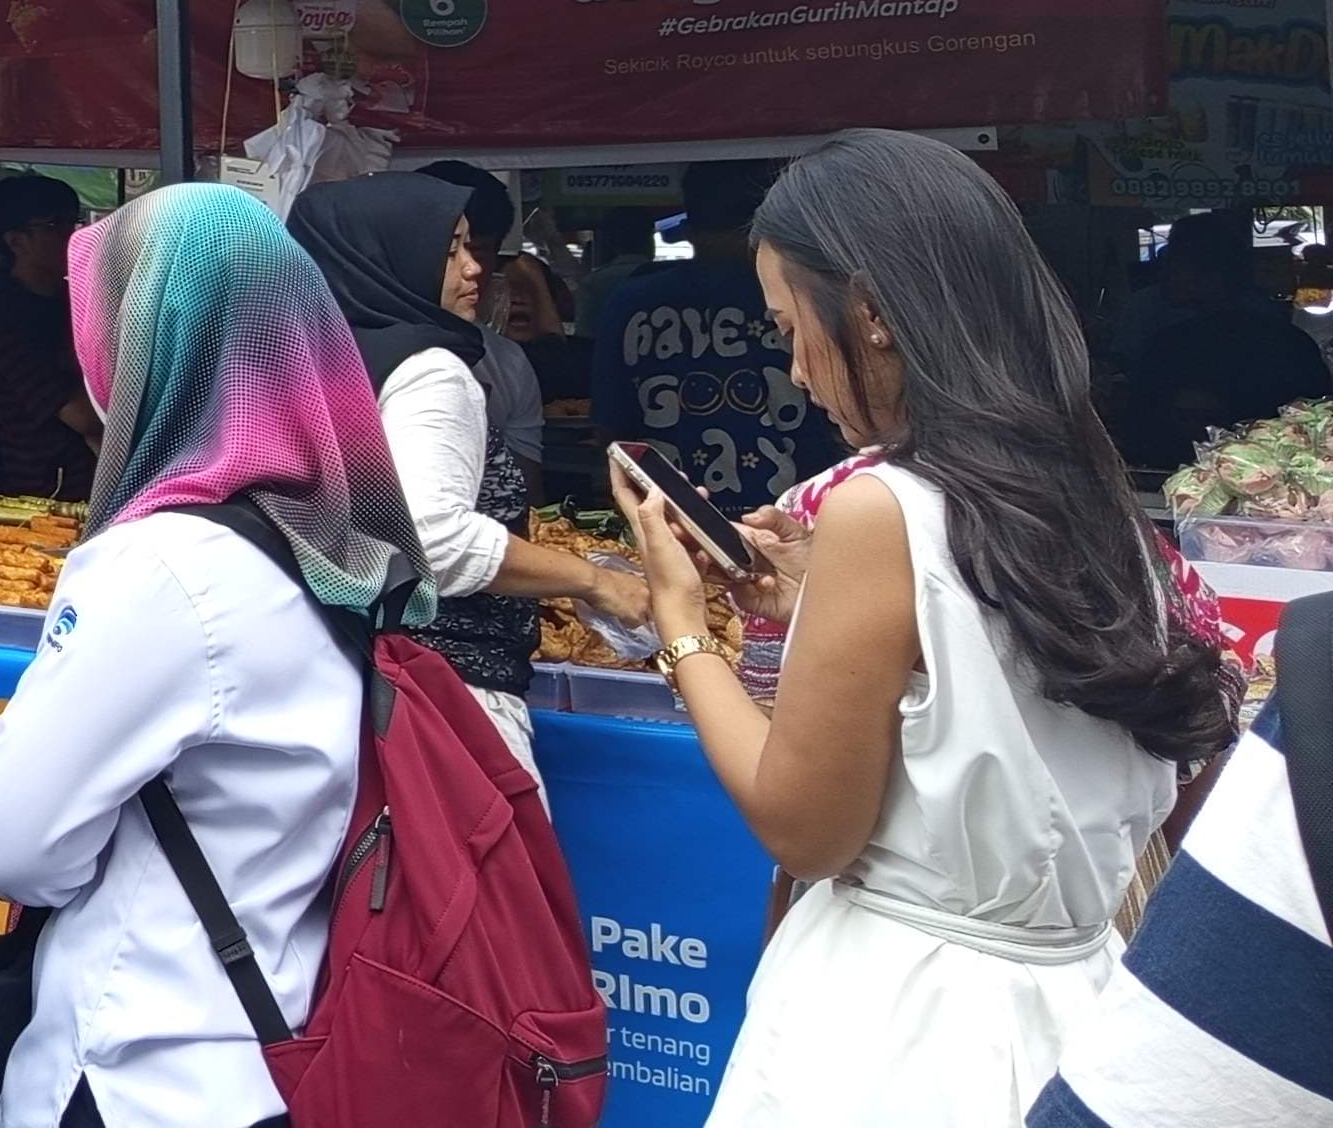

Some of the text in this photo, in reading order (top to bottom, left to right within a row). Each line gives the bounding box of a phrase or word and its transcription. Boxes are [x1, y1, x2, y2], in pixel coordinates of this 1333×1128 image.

[298, 9, 350, 31] oyco
[675, 52, 737, 76] Royco
[740, 45, 800, 68] untuk
[805, 35, 921, 63] sebungkus
[927, 28, 1037, 56] Gorengan
[591, 916, 708, 969] Pake
[622, 1029, 711, 1067] tenang
